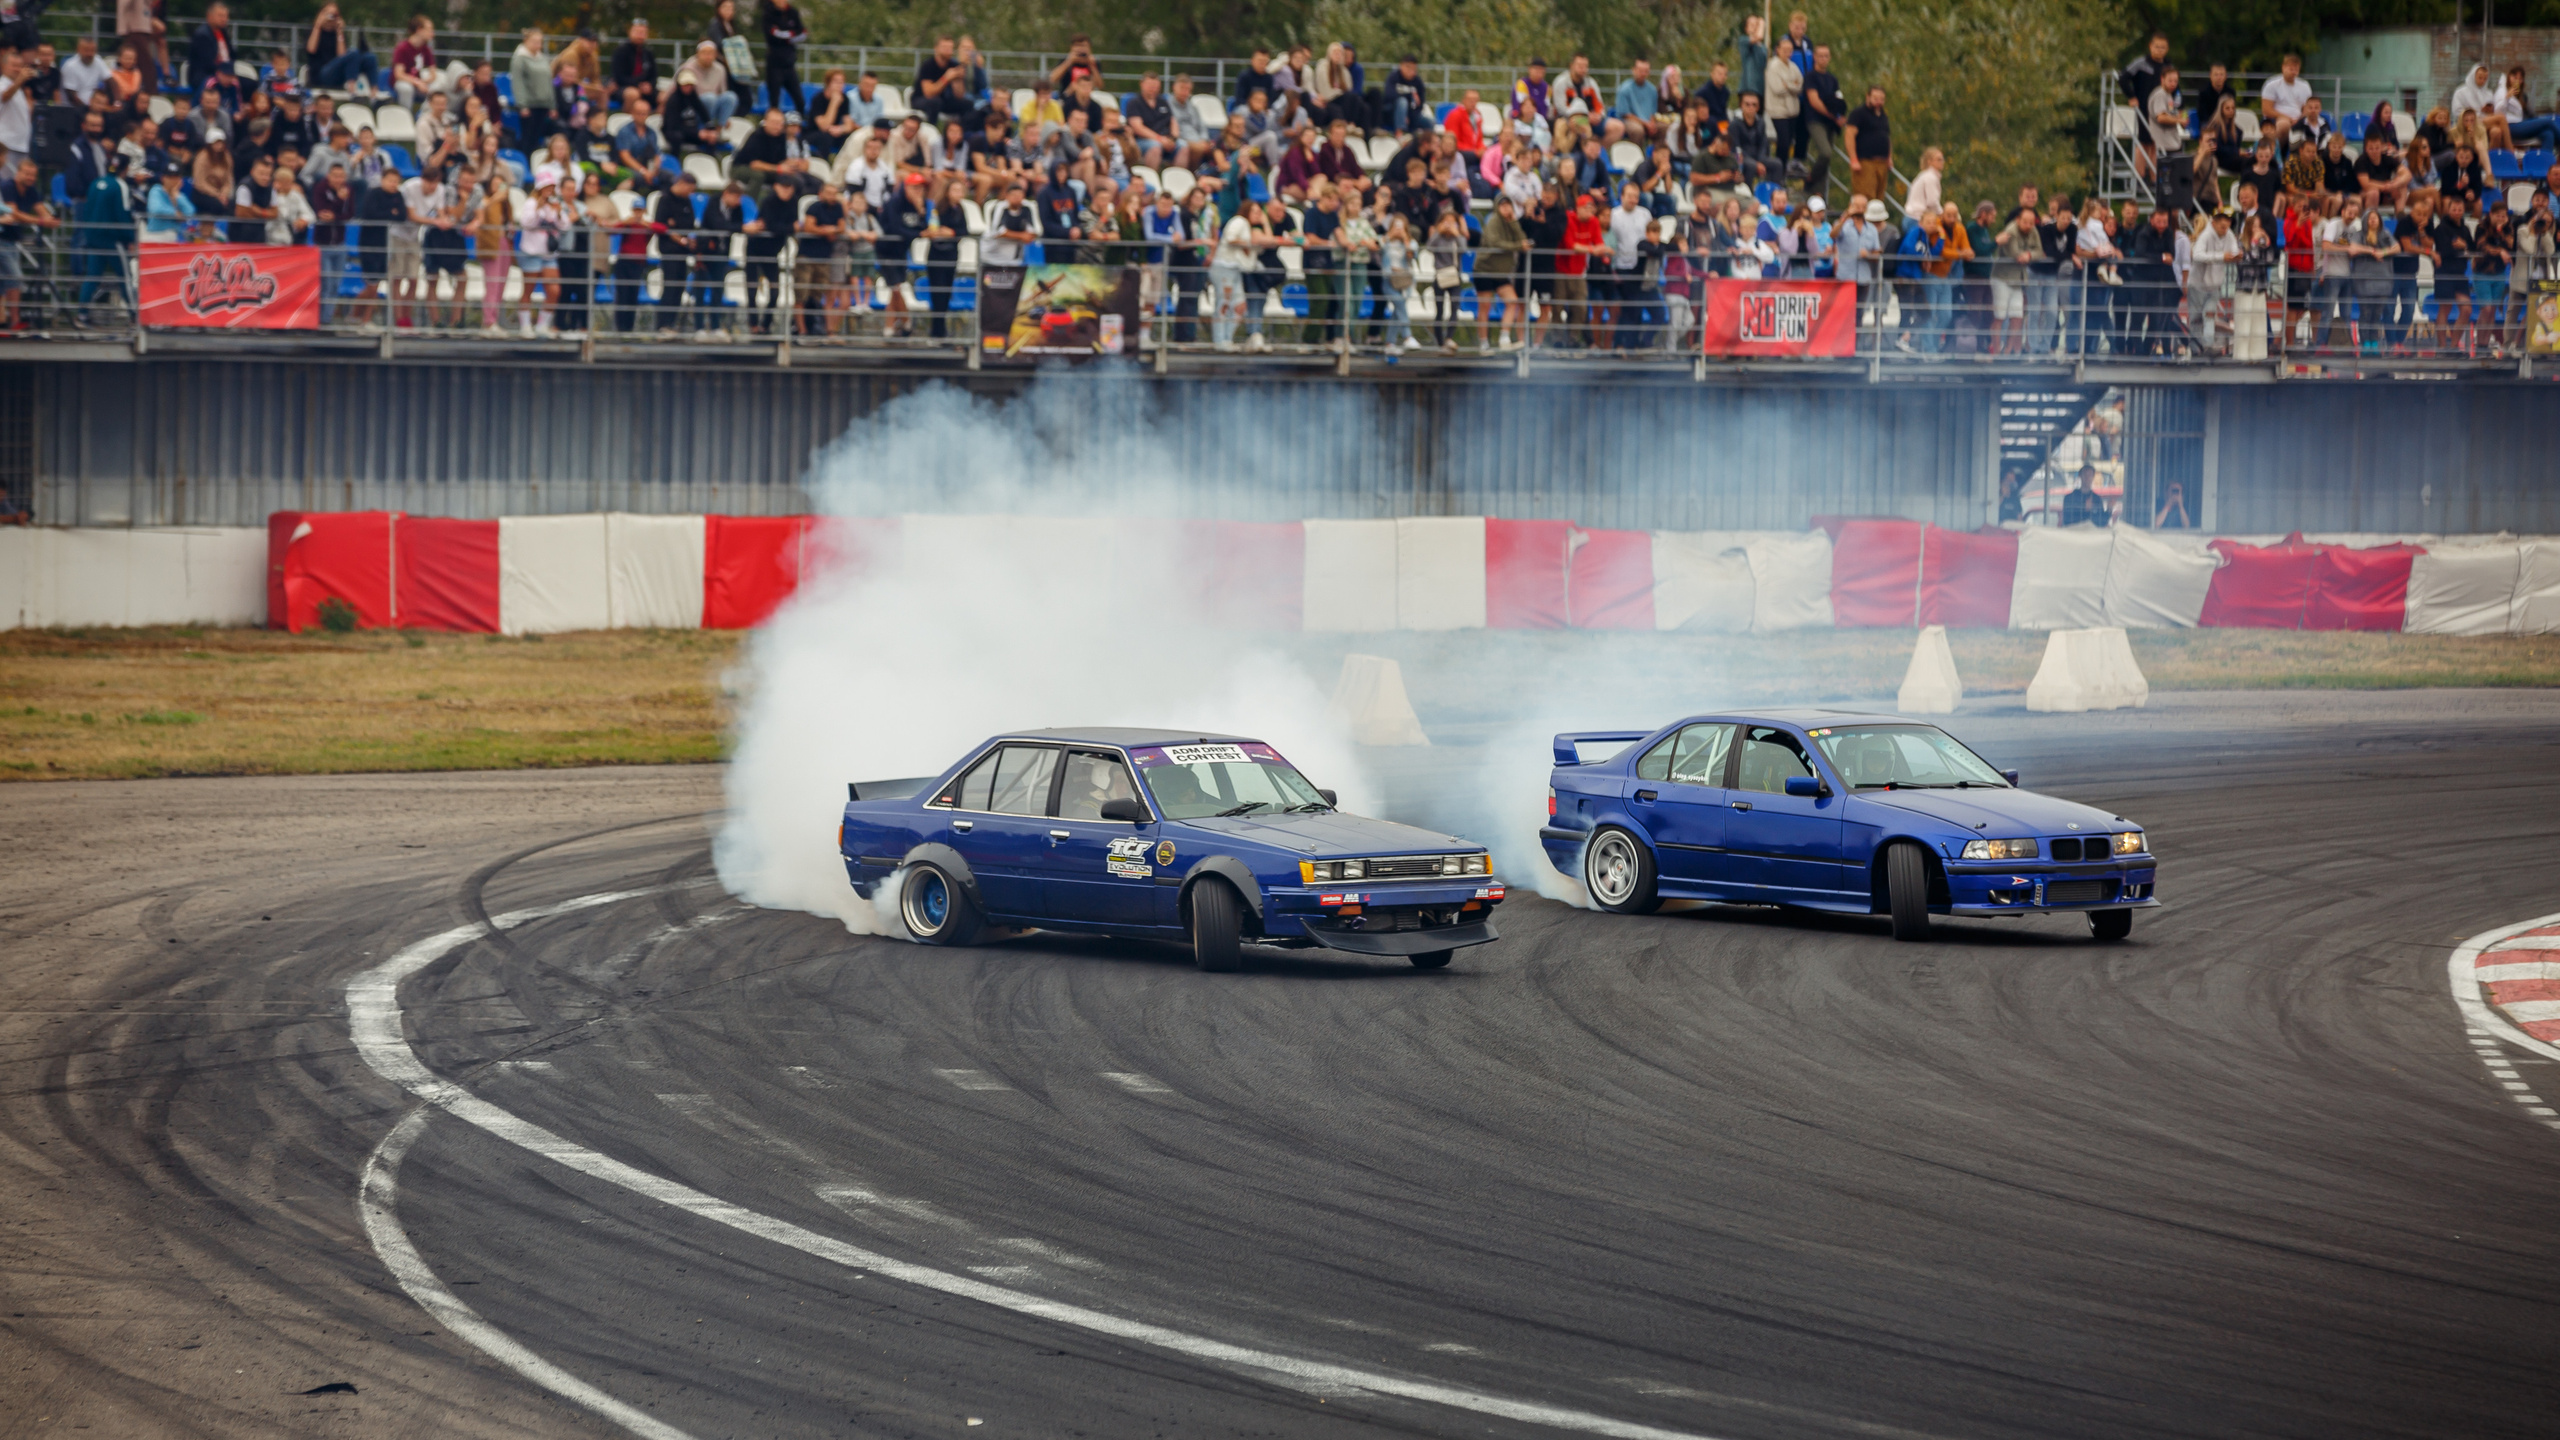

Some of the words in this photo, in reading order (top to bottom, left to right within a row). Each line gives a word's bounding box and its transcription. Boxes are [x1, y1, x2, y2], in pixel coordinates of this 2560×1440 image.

[1742, 296, 1776, 337] NO
[1778, 296, 1818, 316] DRIFT
[1778, 318, 1806, 338] FUN
[1172, 747, 1200, 756] ADM
[1201, 746, 1235, 754] DRIFT
[1176, 753, 1242, 762] CONTEST
[1109, 863, 1151, 873] EVOLUTION
